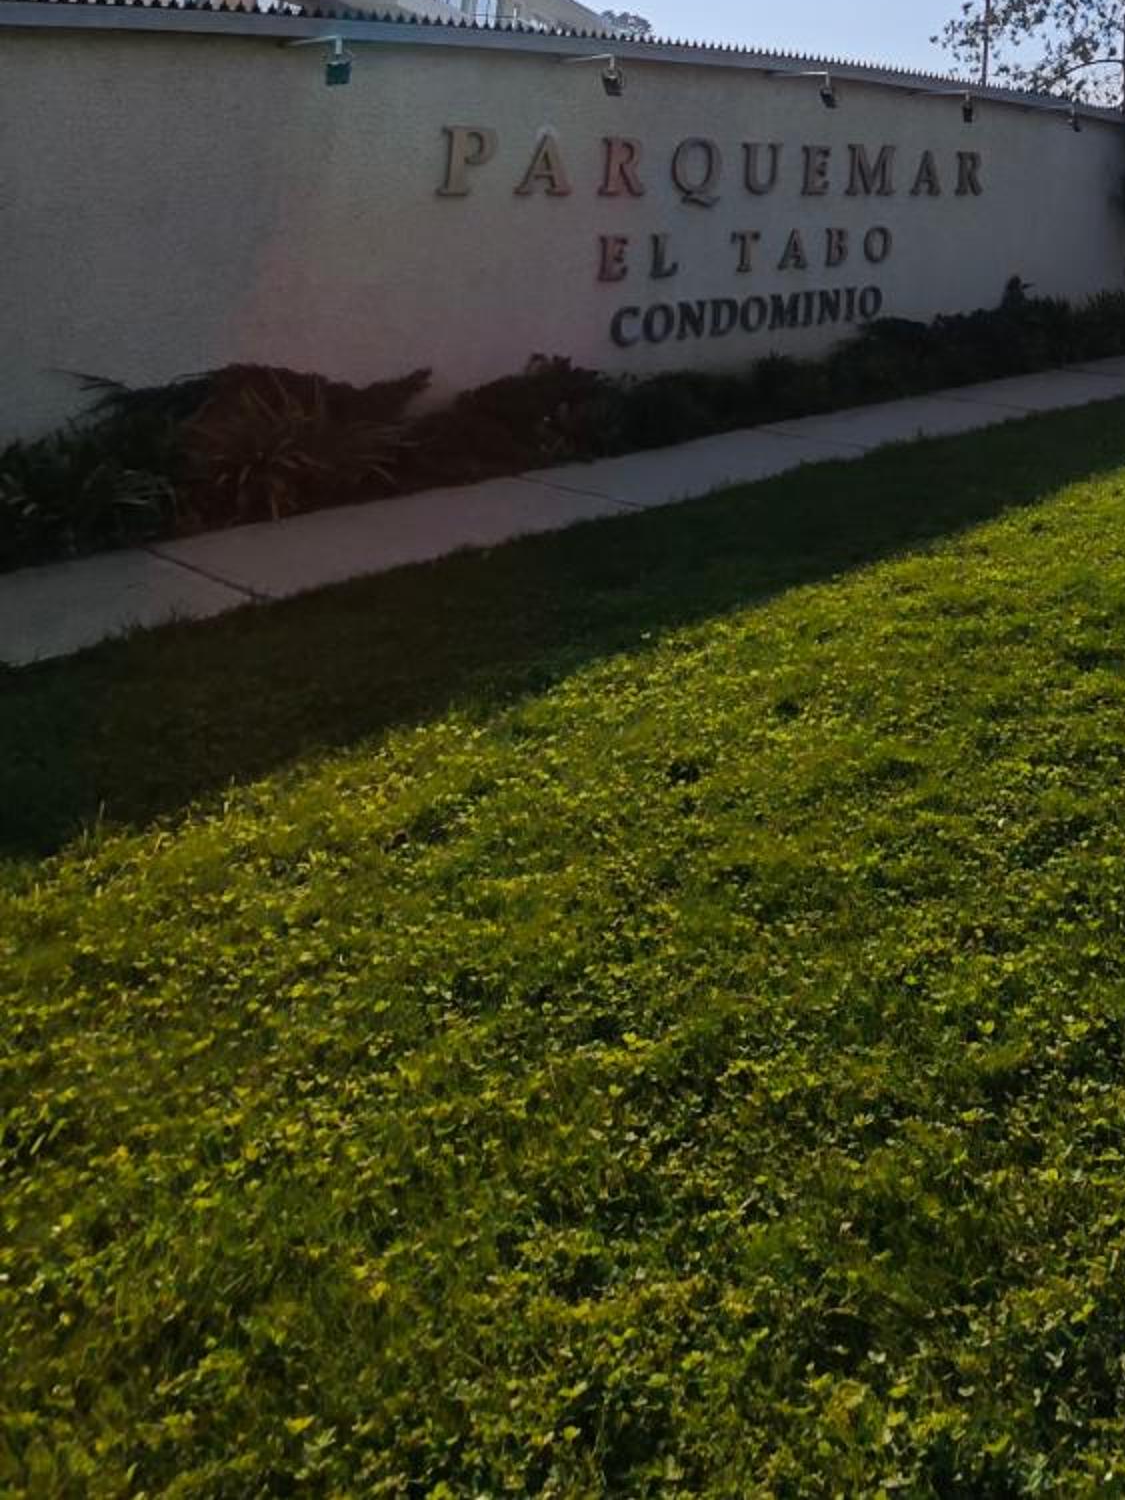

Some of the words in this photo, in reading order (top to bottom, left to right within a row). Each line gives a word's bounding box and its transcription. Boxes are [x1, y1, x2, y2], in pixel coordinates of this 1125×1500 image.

[436, 125, 984, 207] PARQUEMAR
[597, 233, 678, 282] EL
[731, 226, 893, 273] TABO
[609, 285, 883, 348] CONDOMINIO
